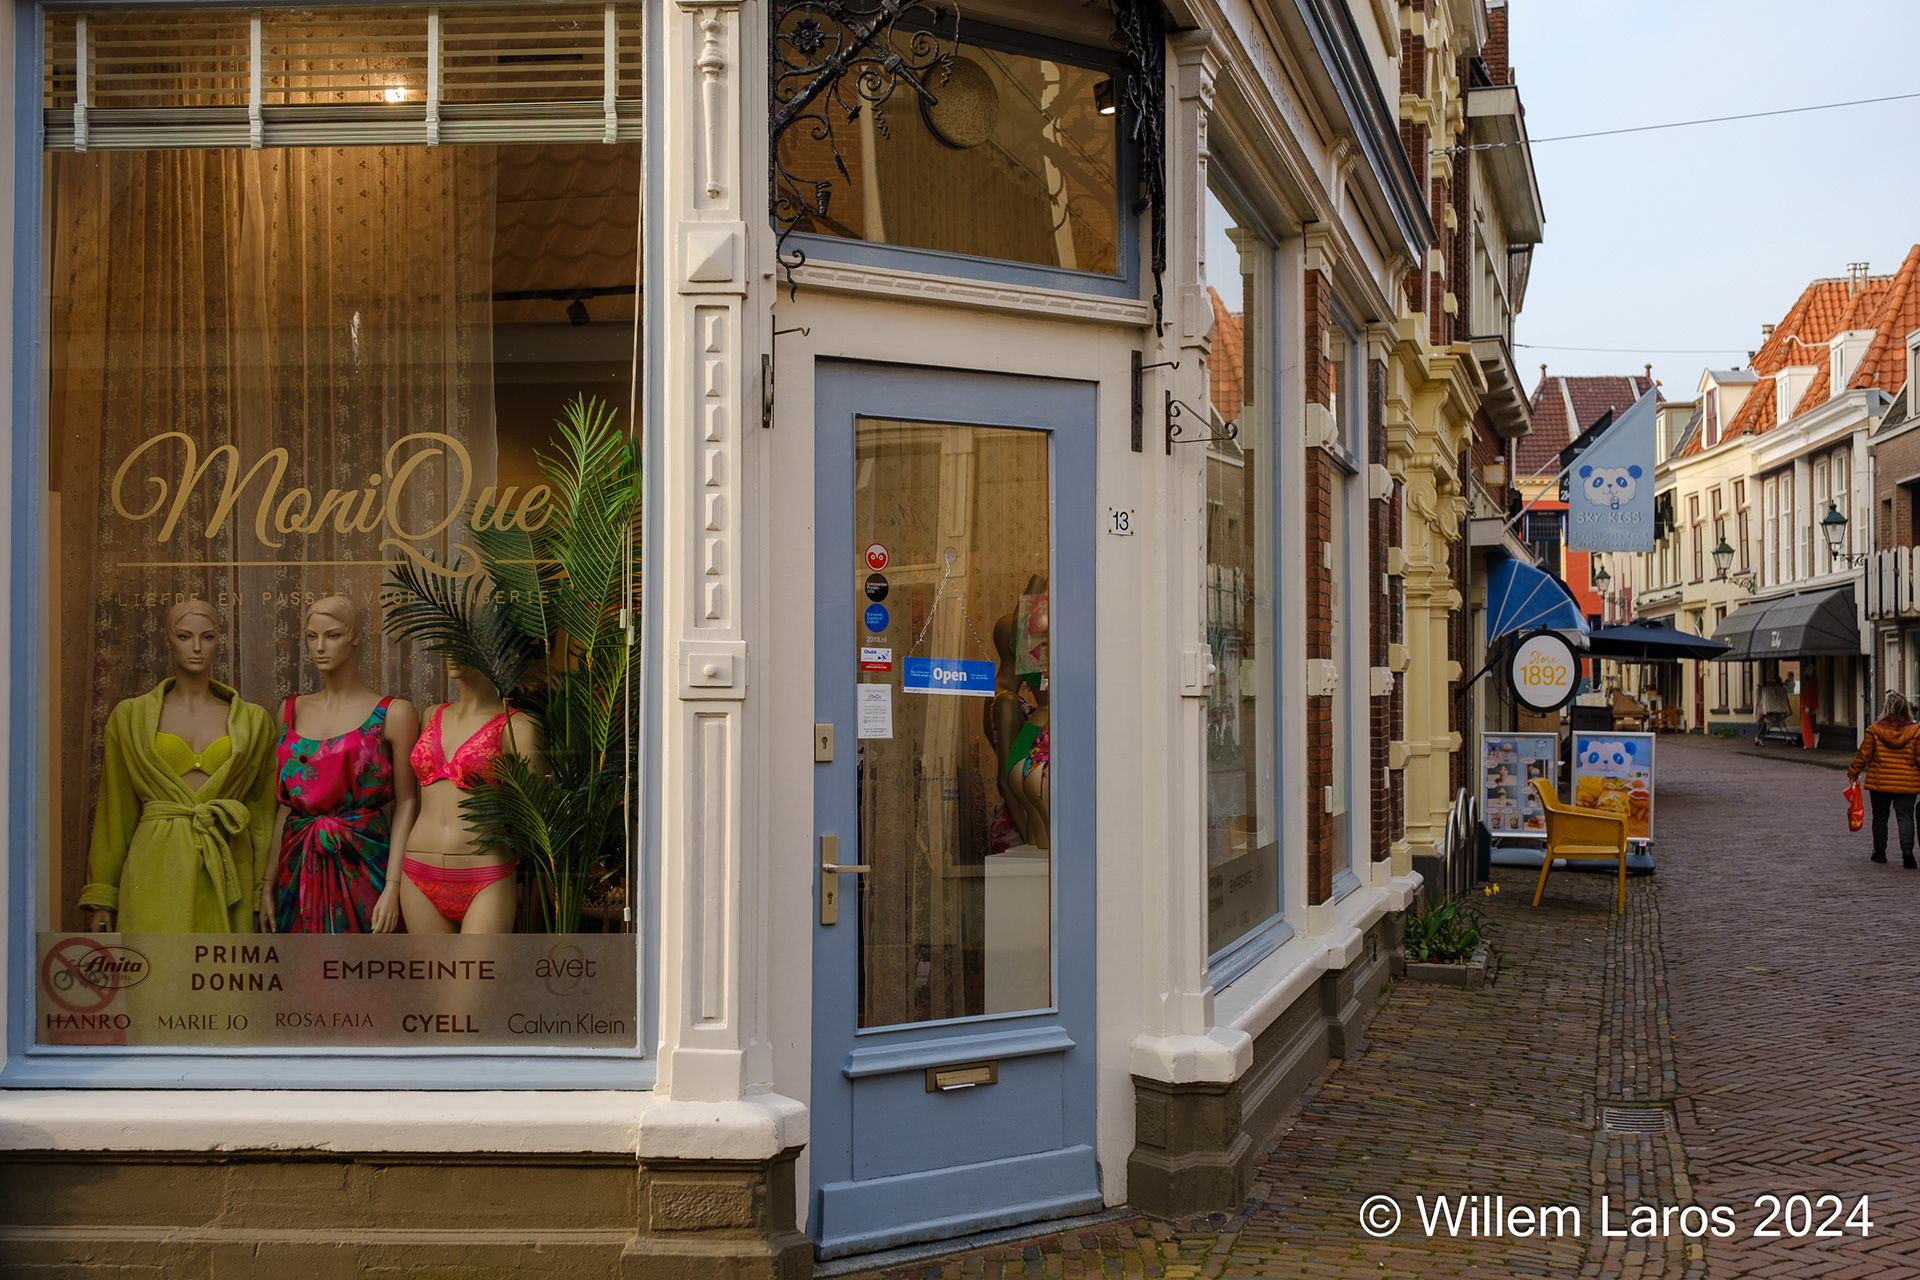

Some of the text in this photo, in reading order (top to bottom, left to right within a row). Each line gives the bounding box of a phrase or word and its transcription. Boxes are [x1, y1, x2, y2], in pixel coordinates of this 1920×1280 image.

[111, 430, 556, 578] MoniQue
[1112, 510, 1130, 531] 13
[1577, 511, 1642, 523] SKY KISS
[117, 590, 550, 607] LIEFDE EN PASSIE VOOR LINGERIE
[866, 635, 887, 643] 2018.nl
[1529, 649, 1558, 665] Store
[932, 667, 967, 685] Open
[1520, 665, 1567, 686] 1892
[195, 945, 280, 964] PRIMA
[84, 955, 143, 973] Anita
[323, 960, 495, 980] EMPREINTE
[535, 958, 597, 978] avet
[191, 973, 283, 991] DONNA
[46, 1013, 131, 1030] HANRO
[158, 1014, 249, 1031] MARIE JO
[276, 1012, 374, 1028] ROSA FAIA
[402, 1014, 480, 1033] CYELL
[508, 1012, 625, 1034] Calvin Klein
